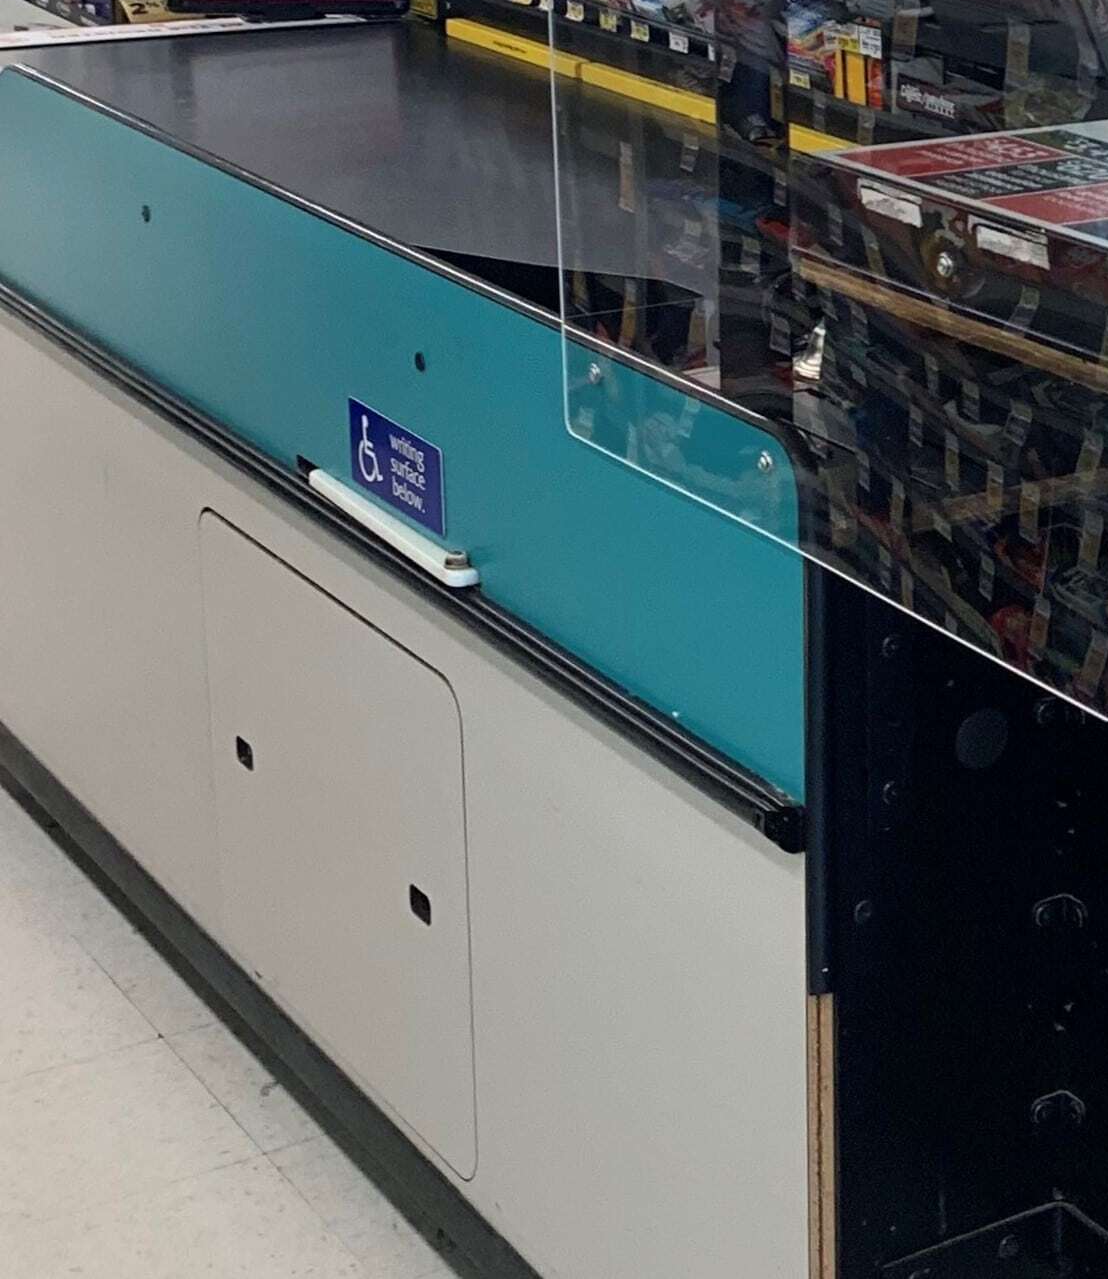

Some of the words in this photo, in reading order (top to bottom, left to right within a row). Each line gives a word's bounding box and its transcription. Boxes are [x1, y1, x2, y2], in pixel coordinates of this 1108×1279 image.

[388, 433, 426, 473] writing
[390, 457, 426, 491] surface
[391, 475, 427, 514] below.
